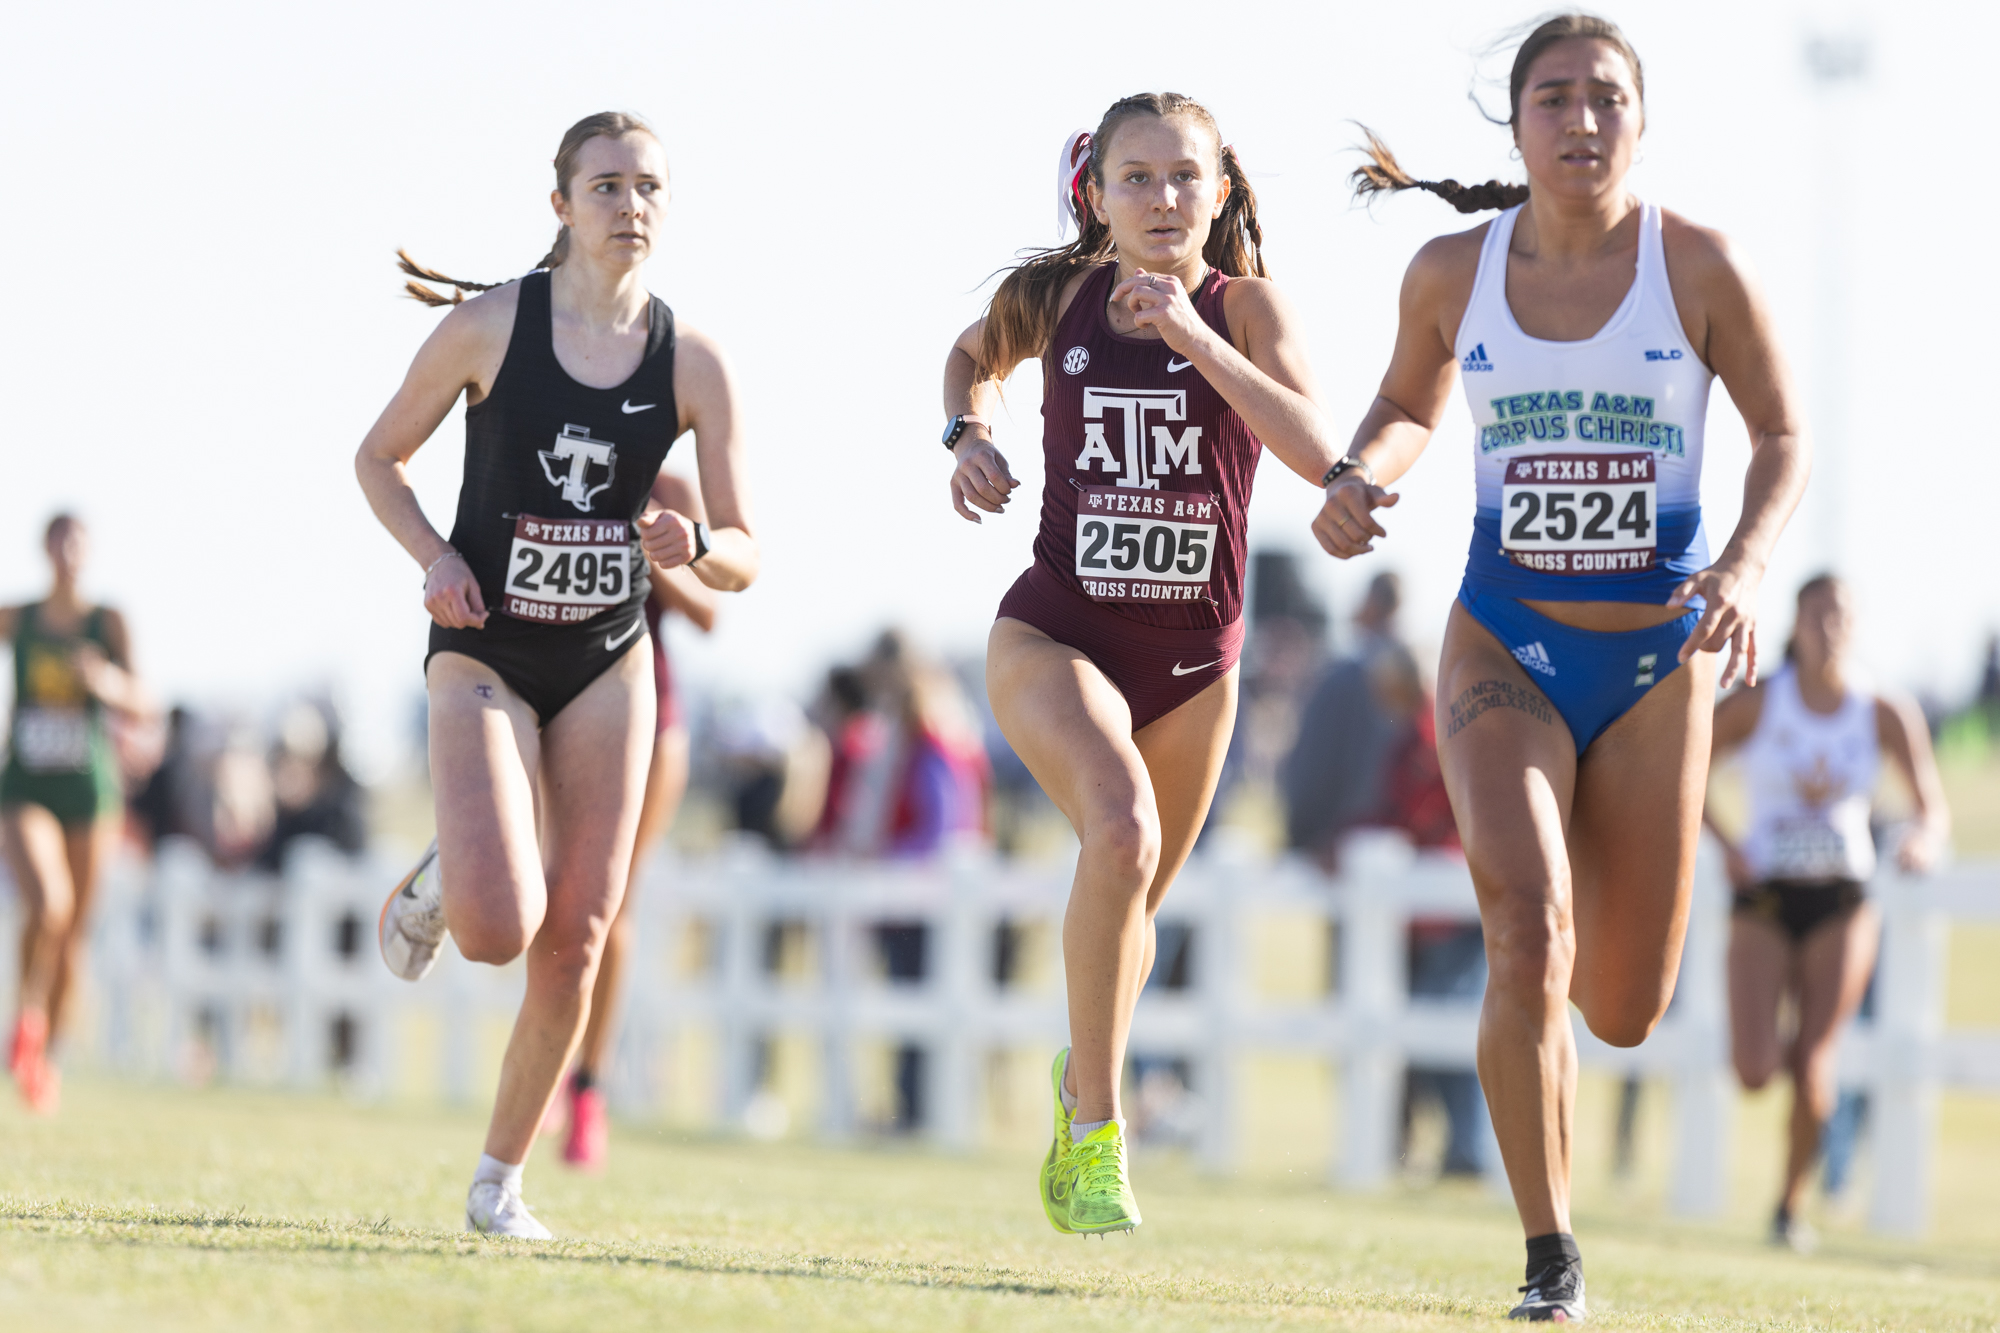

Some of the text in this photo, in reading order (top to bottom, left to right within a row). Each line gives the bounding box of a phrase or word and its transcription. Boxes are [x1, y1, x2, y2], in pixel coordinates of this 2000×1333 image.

[1064, 348, 1088, 373] SEC
[1462, 361, 1494, 372] adidas
[1491, 391, 1655, 420] TEXAS A&M
[1481, 414, 1685, 457] CORPUS CHRISTI
[1534, 461, 1599, 480] TEXAS
[1607, 459, 1648, 479] A&M
[1104, 493, 1165, 515] TEXAS
[1173, 500, 1212, 519] A&M
[1509, 490, 1651, 542] 2524
[541, 522, 591, 543] TEXAS
[595, 525, 625, 543] A&M
[1080, 520, 1209, 576] 2505
[1573, 550, 1651, 571] COUNTRY
[512, 547, 623, 596] 2495
[1082, 580, 1203, 600] CROSS COUNTRY
[510, 598, 606, 622] CROSS COUN
